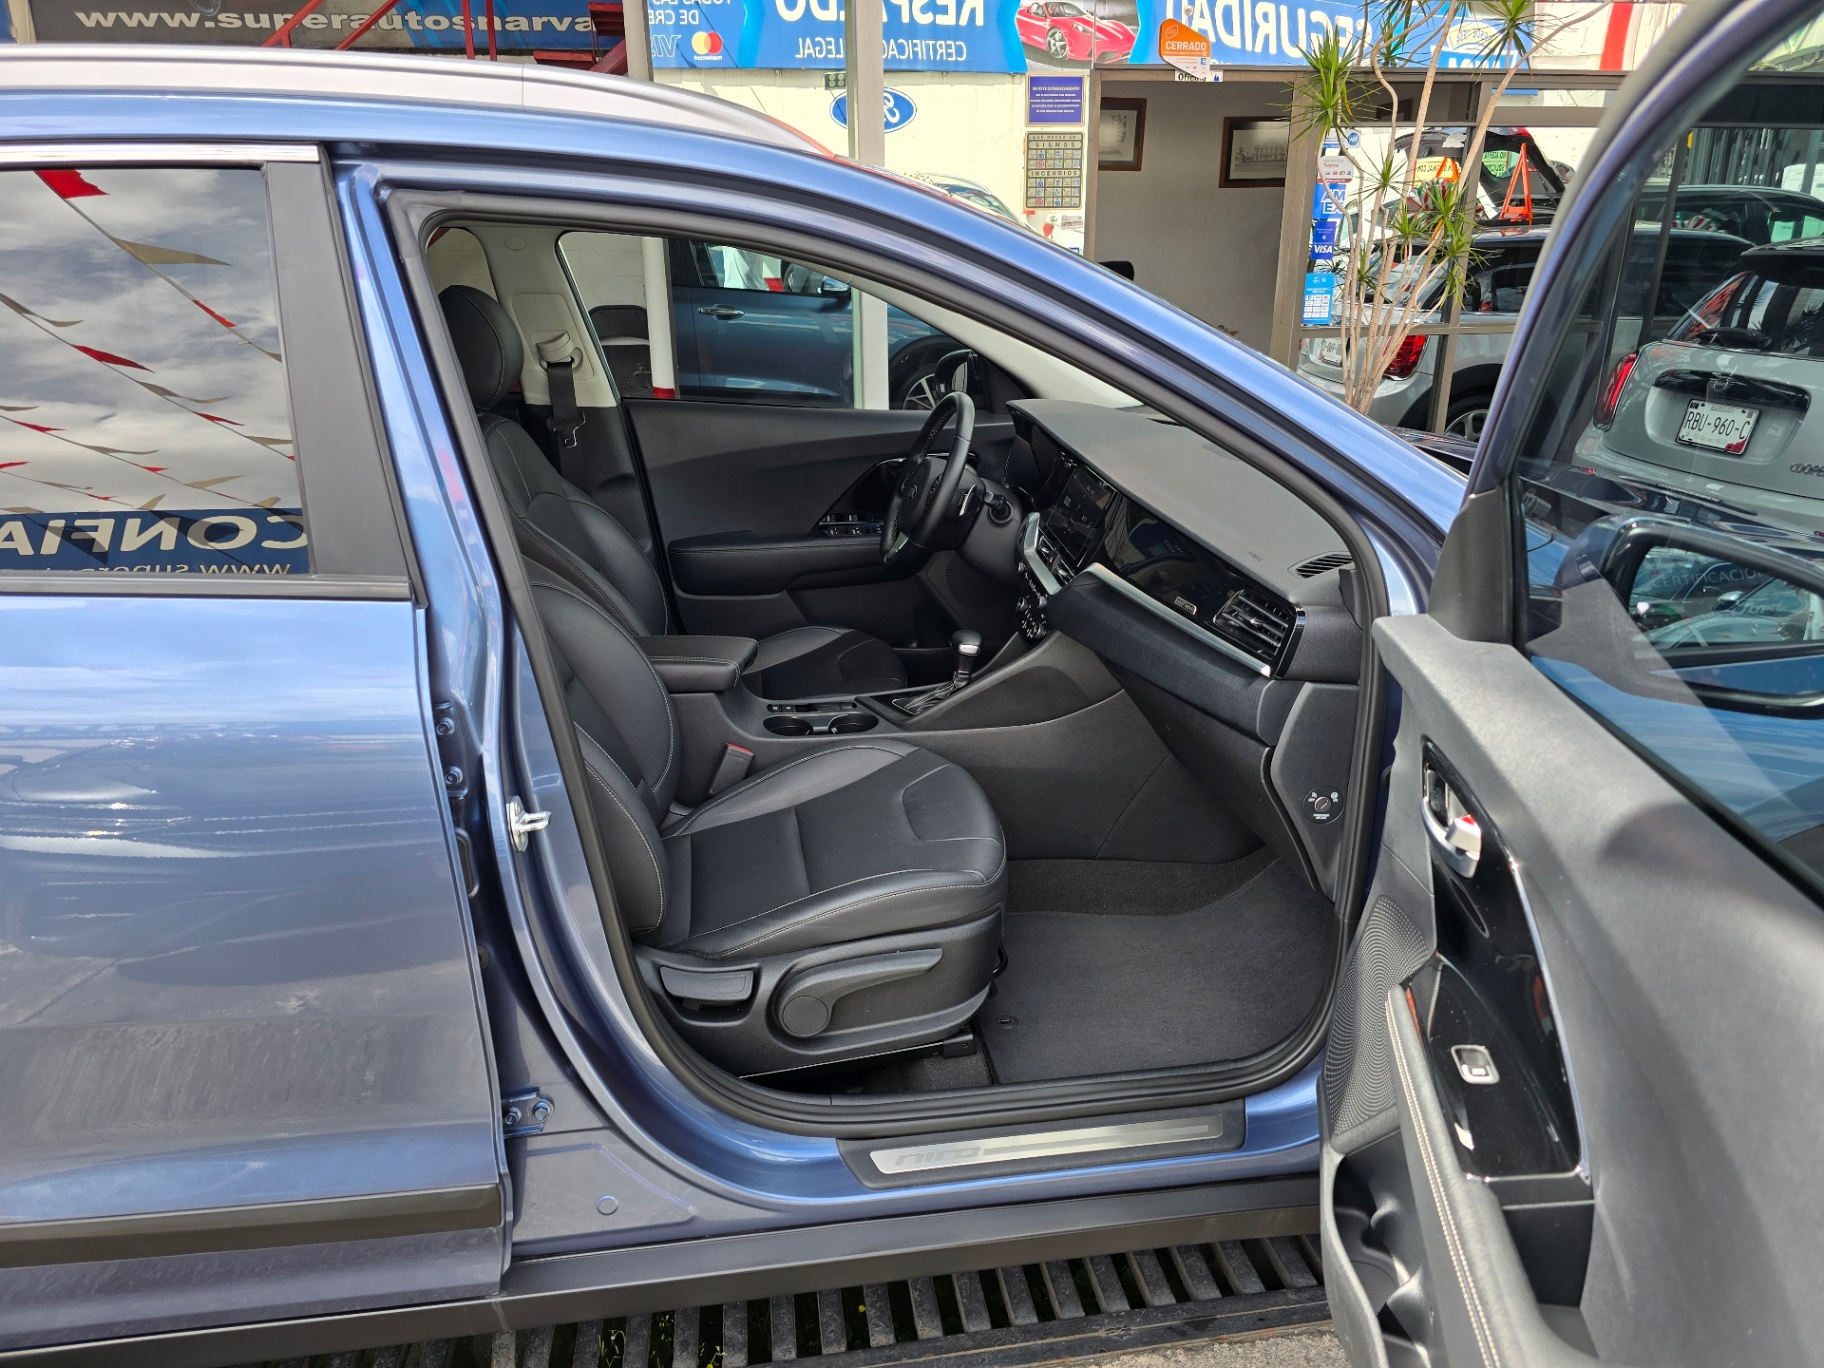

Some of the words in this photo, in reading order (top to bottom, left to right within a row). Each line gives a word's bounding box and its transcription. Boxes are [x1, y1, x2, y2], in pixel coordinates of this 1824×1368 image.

[1165, 40, 1207, 51] CERRADO
[1314, 245, 1333, 254] VISA
[1684, 411, 1751, 440] RBU-960-C
[1790, 463, 1824, 478] COOPE
